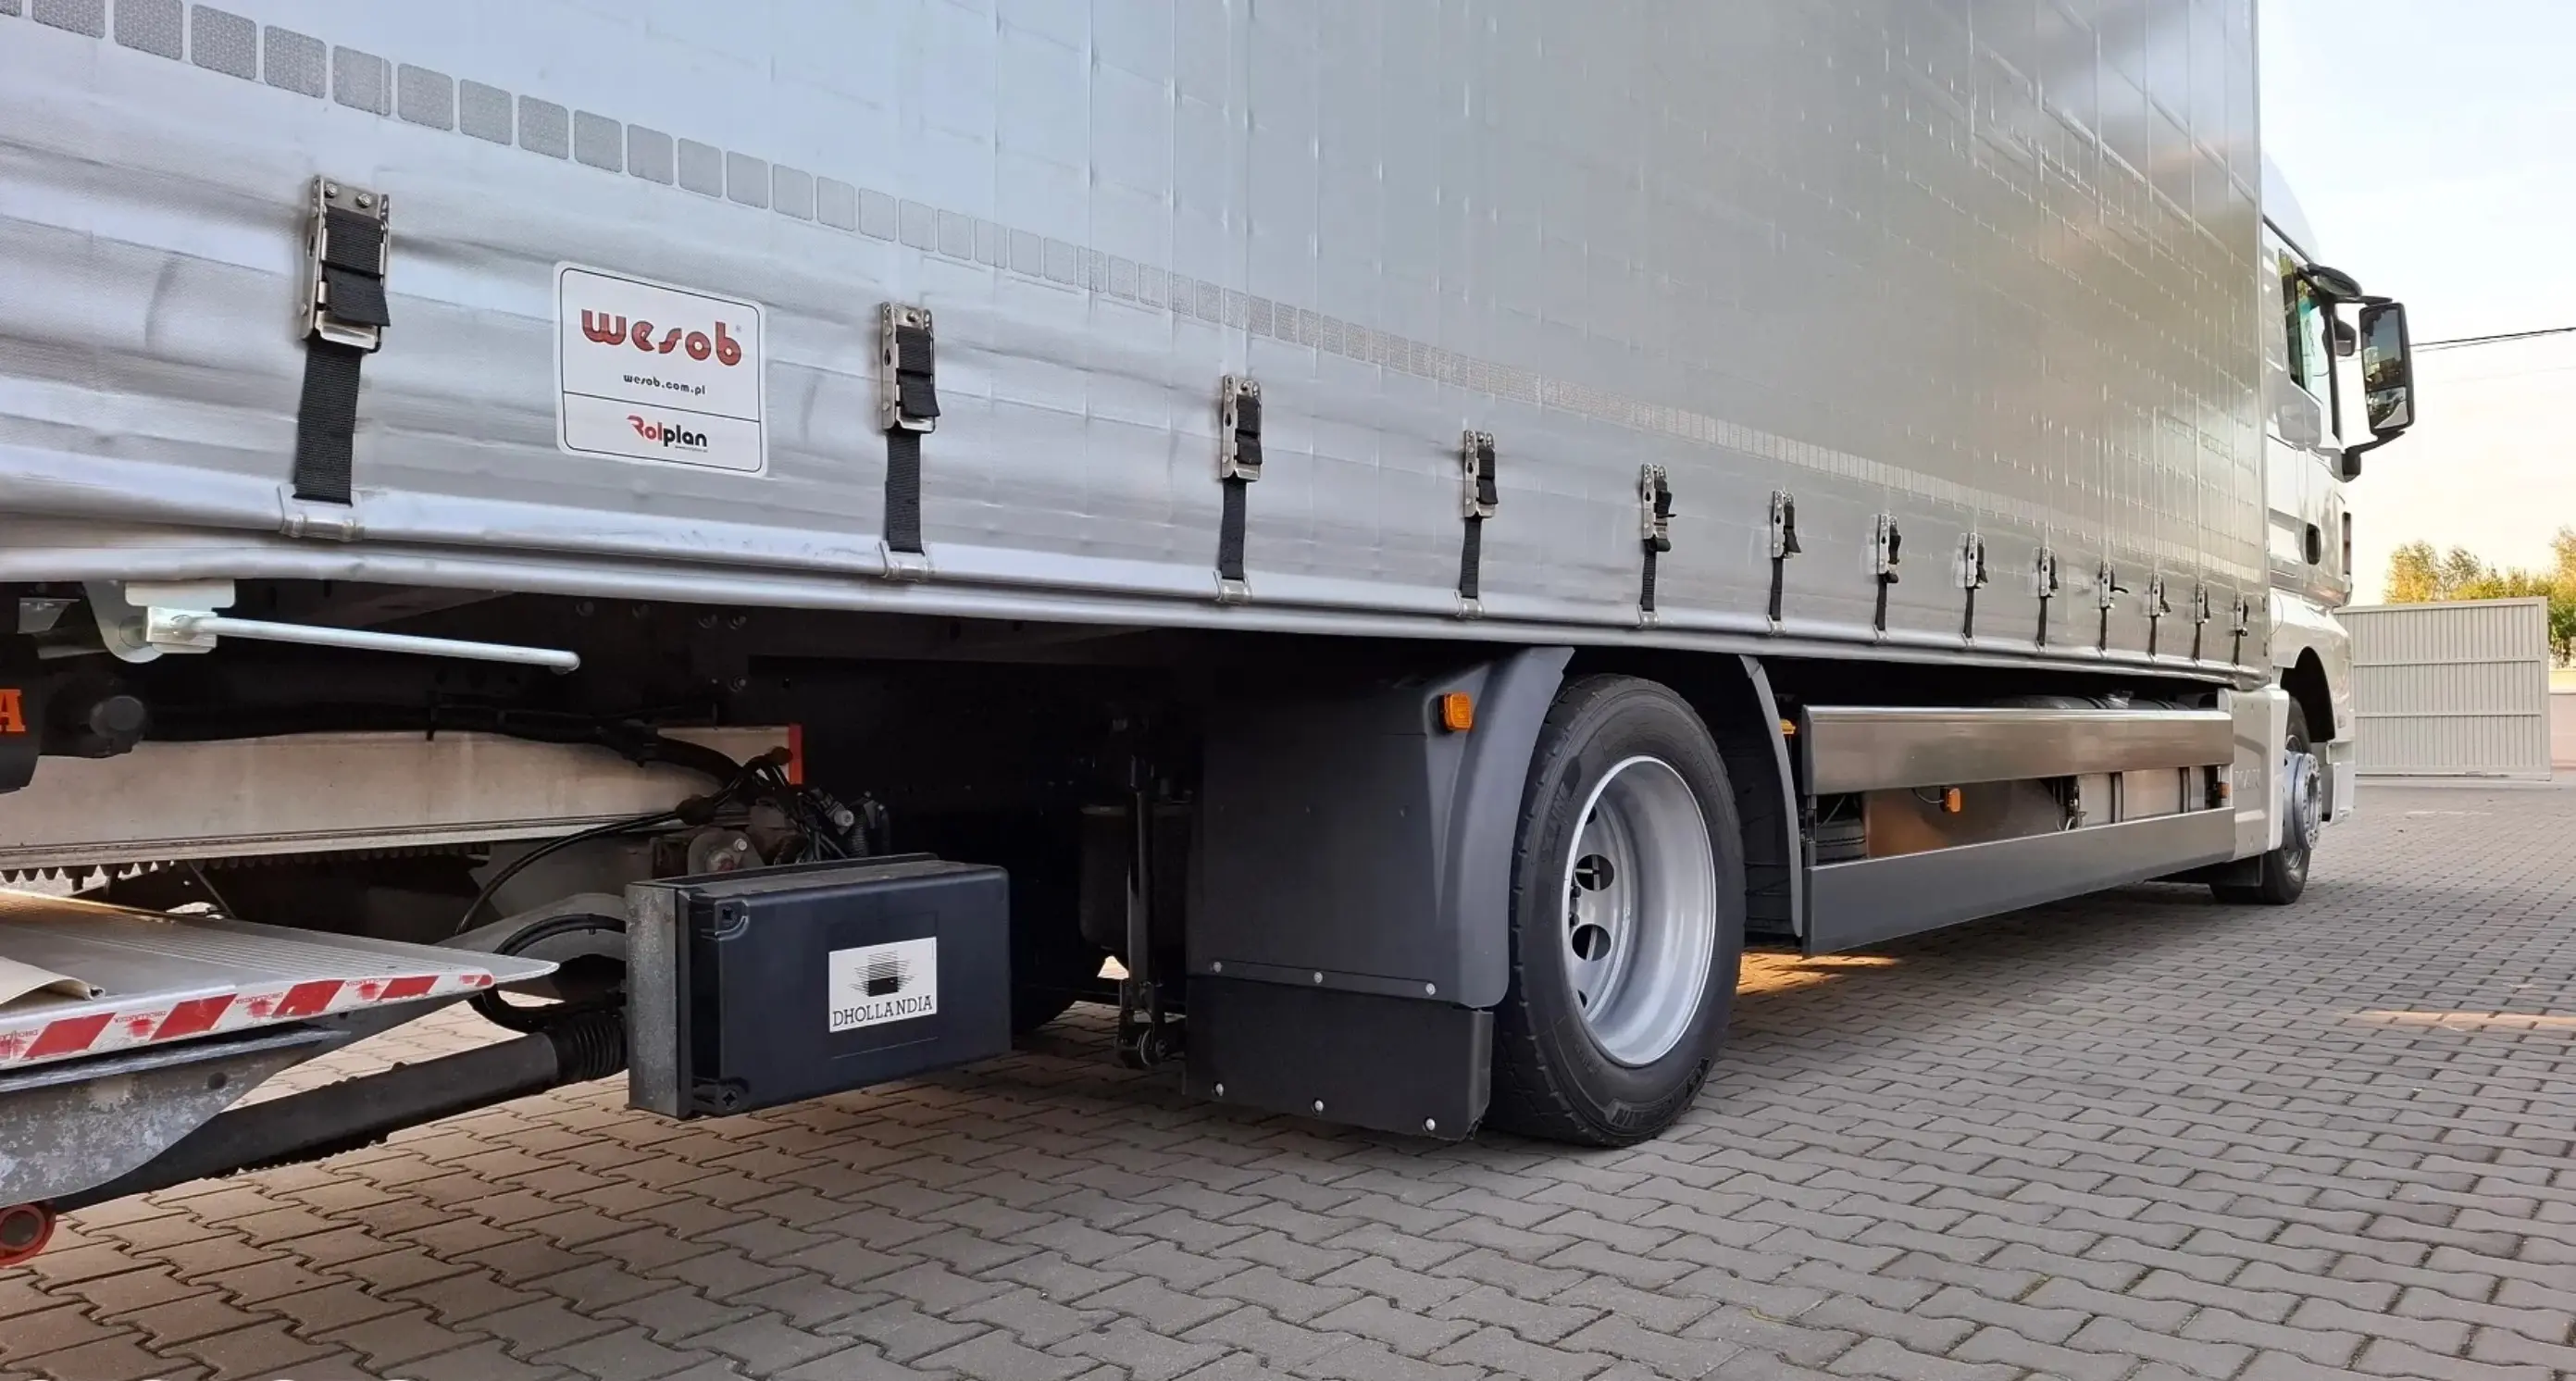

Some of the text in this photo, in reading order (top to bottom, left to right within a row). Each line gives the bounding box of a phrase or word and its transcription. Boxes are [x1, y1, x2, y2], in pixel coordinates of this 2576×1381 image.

[581, 309, 742, 367] wesob
[623, 374, 706, 396] wesob.com.pl
[626, 415, 708, 447] Rolplan
[832, 995, 933, 1027] DHOLLANDIA
